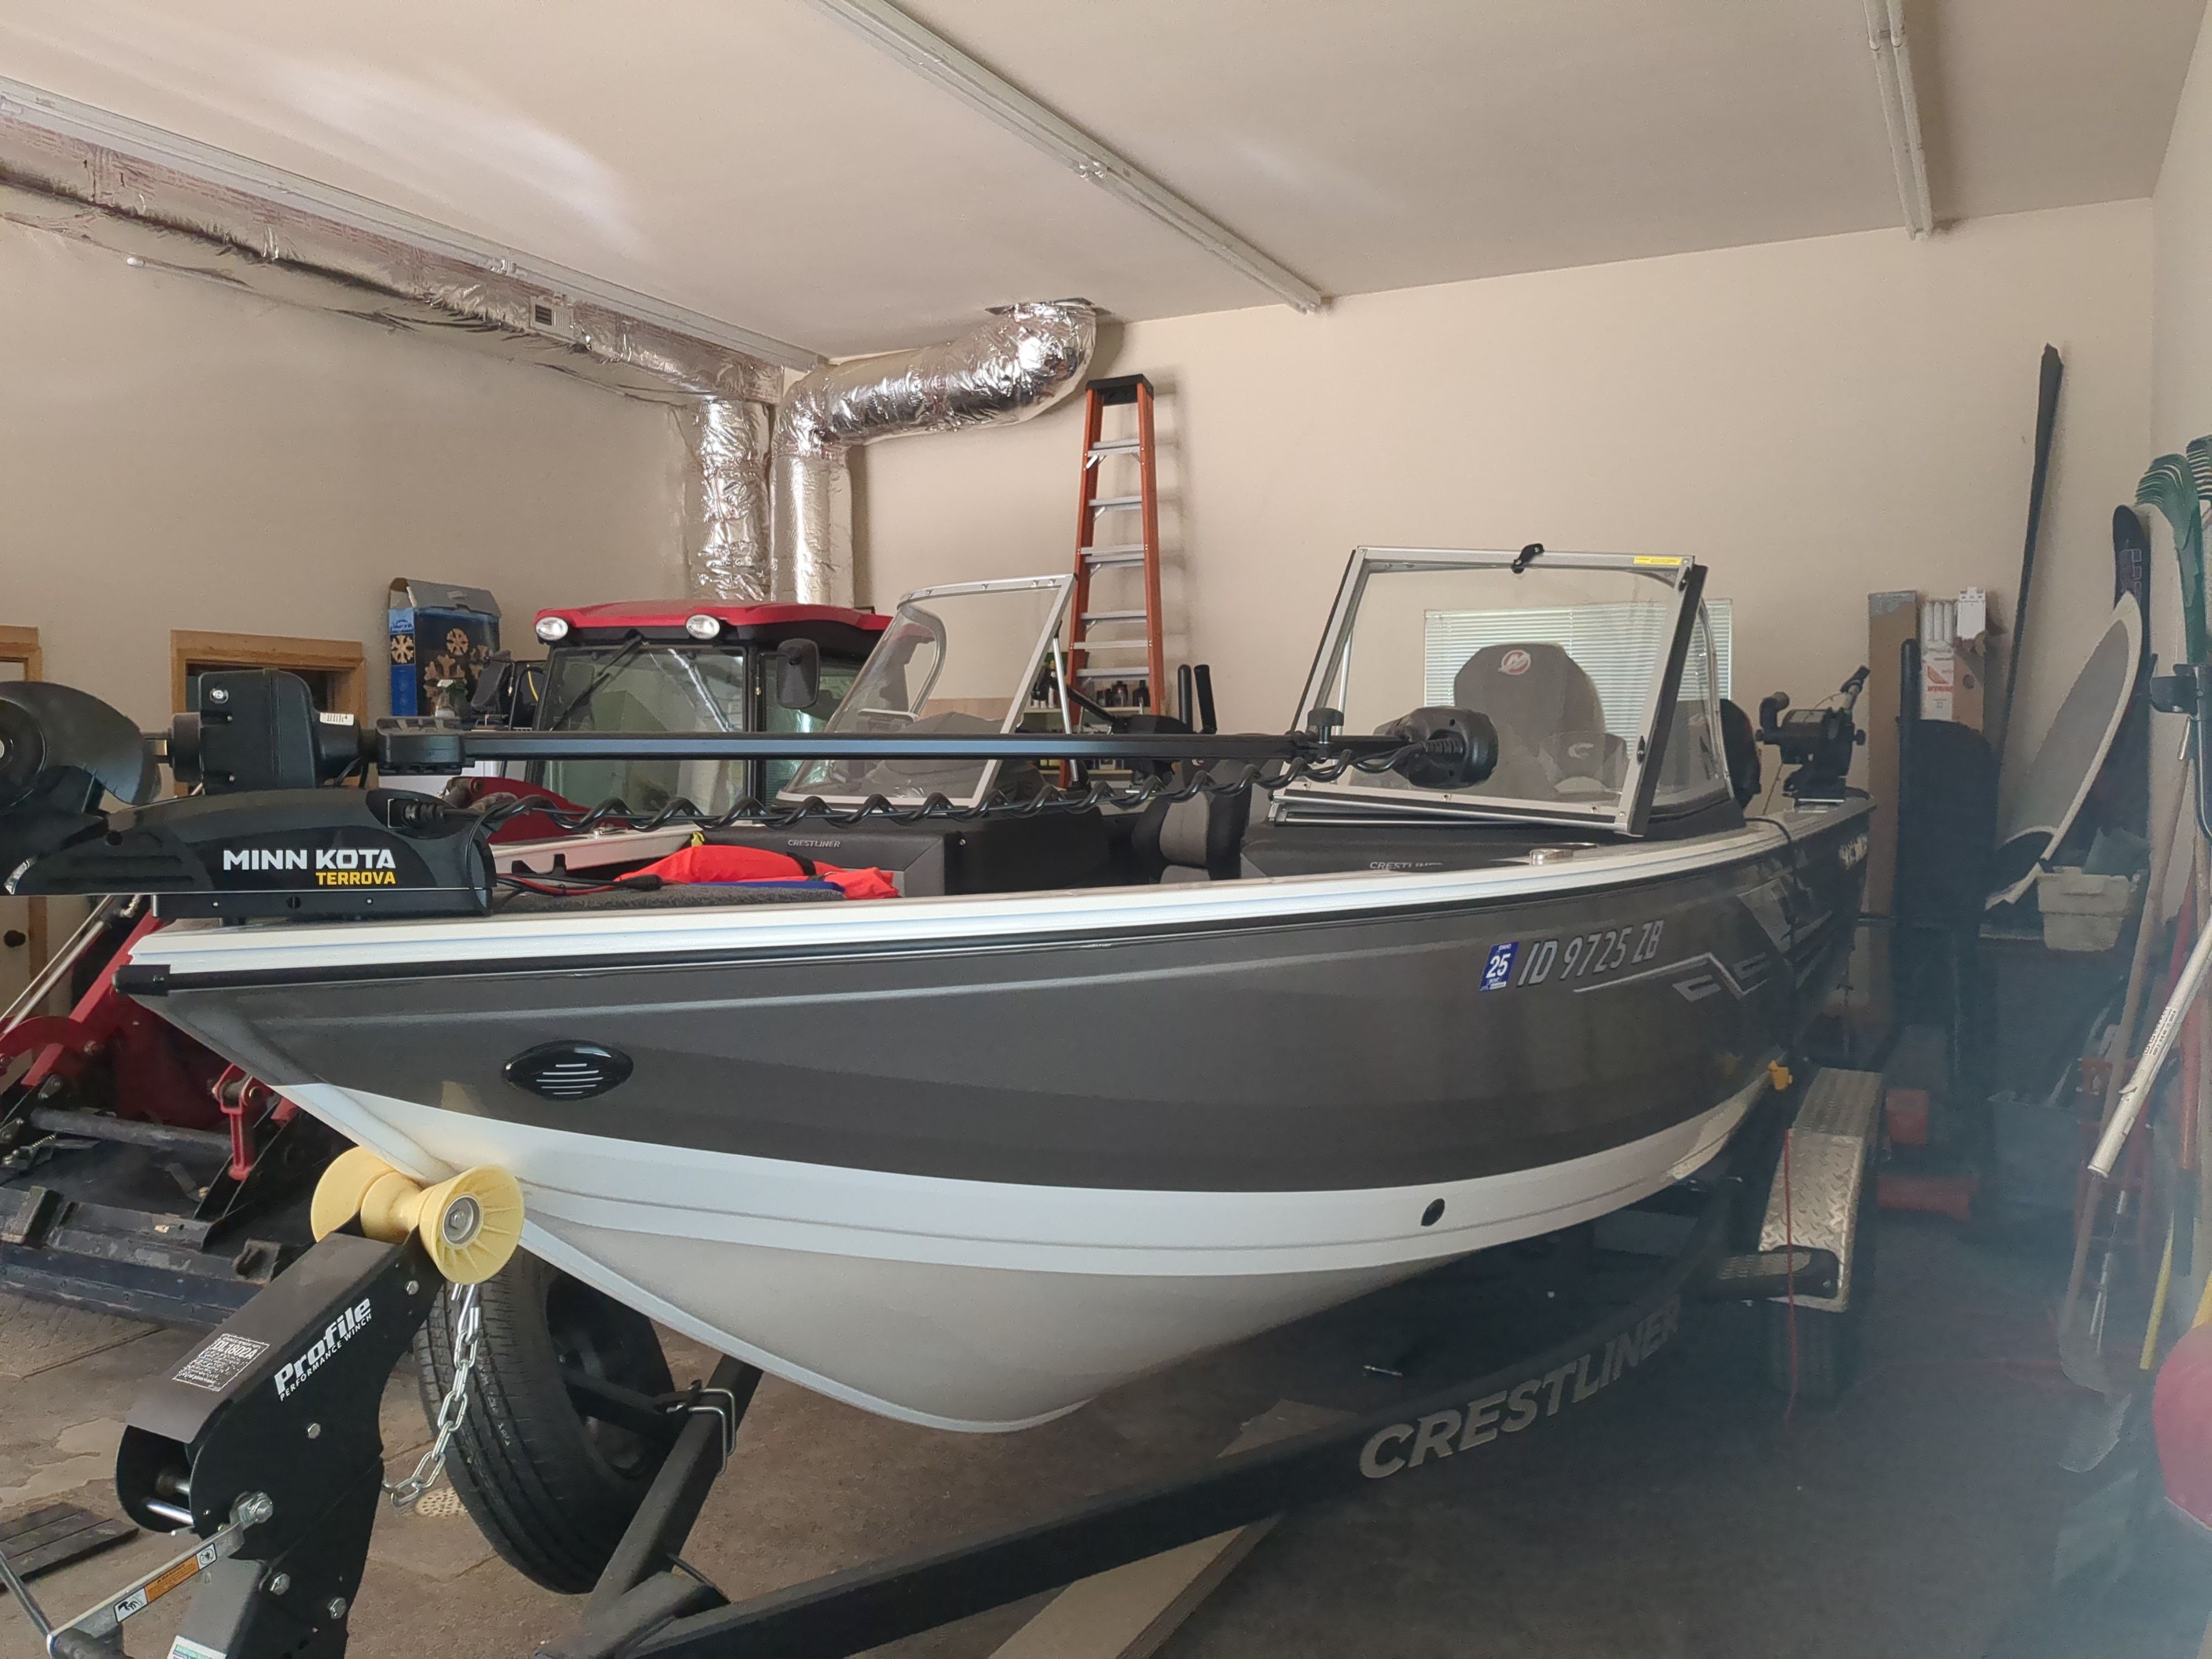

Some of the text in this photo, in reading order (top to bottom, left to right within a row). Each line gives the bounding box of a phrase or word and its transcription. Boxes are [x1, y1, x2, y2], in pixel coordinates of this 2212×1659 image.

[788, 839, 840, 848] CRESTLINER
[223, 849, 396, 870] MINN KOTA
[315, 871, 396, 885] TERROVA
[1486, 953, 1511, 979] 25
[1516, 940, 1559, 986] ID
[1560, 926, 1634, 980] 9725
[211, 1340, 259, 1360] DL1802A
[274, 1298, 371, 1395] Profile
[280, 1341, 342, 1402] PERFORMANCE
[344, 1313, 372, 1342] WINCH
[1359, 1295, 1681, 1479] CRESTLINER
